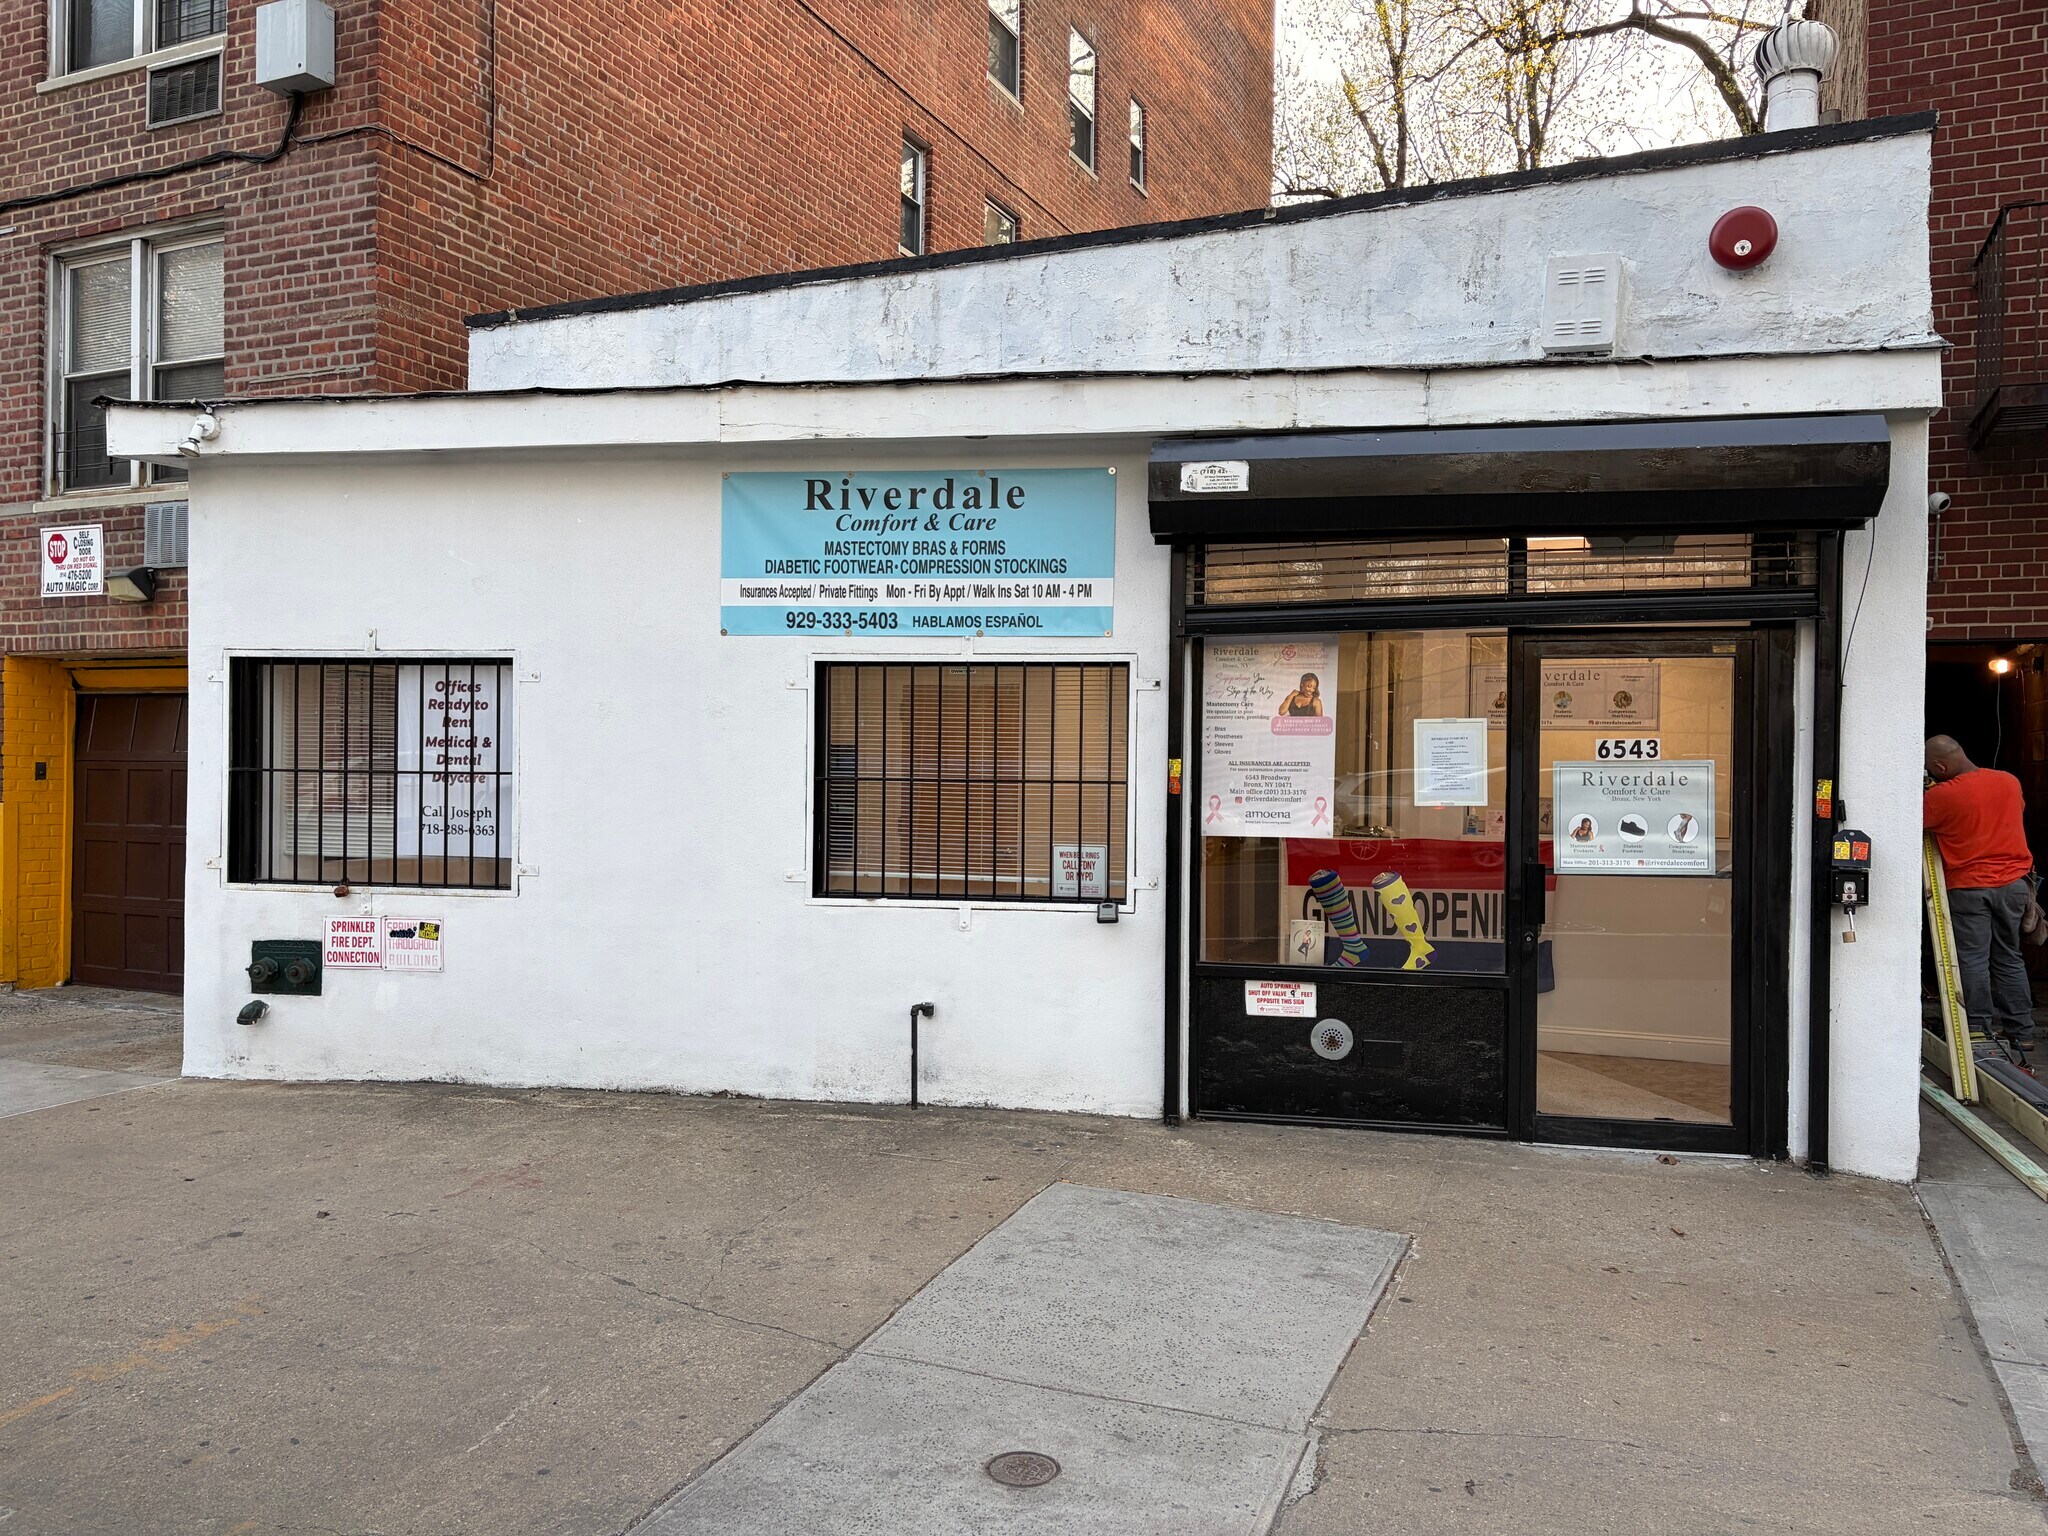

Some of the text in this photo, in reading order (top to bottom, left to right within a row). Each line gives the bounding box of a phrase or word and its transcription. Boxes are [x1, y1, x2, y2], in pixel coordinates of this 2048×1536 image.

[803, 477, 1026, 511] Riverdale
[835, 513, 997, 536] Comfort & Care
[79, 531, 89, 539] SELF
[73, 536, 93, 549] CLOSING
[824, 540, 1006, 556] MASTECTOMY BRAS & FORMS
[49, 540, 66, 558] STOP
[765, 559, 821, 574] DIABETIC
[994, 559, 1067, 574] STOCKINGS
[68, 569, 92, 580] 476-5200
[45, 582, 63, 592] AUTO
[65, 581, 87, 591] MAGIC
[740, 584, 777, 598] Insurances
[779, 584, 811, 602] Accepted
[819, 584, 846, 598] Private
[849, 584, 878, 602] Fittings
[886, 584, 906, 598] Mon
[914, 584, 926, 598] Fri
[929, 584, 941, 602] By
[943, 584, 965, 602] Appt
[973, 584, 995, 598] Walk
[998, 584, 1012, 598] Ins
[1014, 584, 1030, 598] Sat
[1032, 584, 1043, 598] 10
[1045, 584, 1061, 598] AM
[1068, 584, 1074, 598] 4
[1077, 584, 1092, 598] PM
[785, 611, 1043, 630] 929-333-5403 HABLAMOS ESPAÑOL
[1213, 648, 1259, 656] Riverdale
[1544, 670, 1601, 681] verdale
[428, 698, 489, 713] Ready to
[482, 737, 492, 748] &
[1597, 739, 1659, 759] 6543
[1581, 771, 1689, 787] Riverdale
[1602, 788, 1637, 796] Comfort
[1245, 810, 1291, 819] amoena
[1062, 860, 1096, 870] CALL FDNY
[1644, 859, 1706, 867] @riverdalecomfort
[1066, 871, 1074, 881] OR
[1303, 889, 1505, 939] GAND OPENI
[331, 921, 375, 933] SPRINKLER
[331, 936, 375, 948] FIRE DEPT.
[388, 939, 438, 950] THROUGHOUT
[327, 951, 380, 963] CONNECTION
[389, 954, 438, 967] BUILDING
